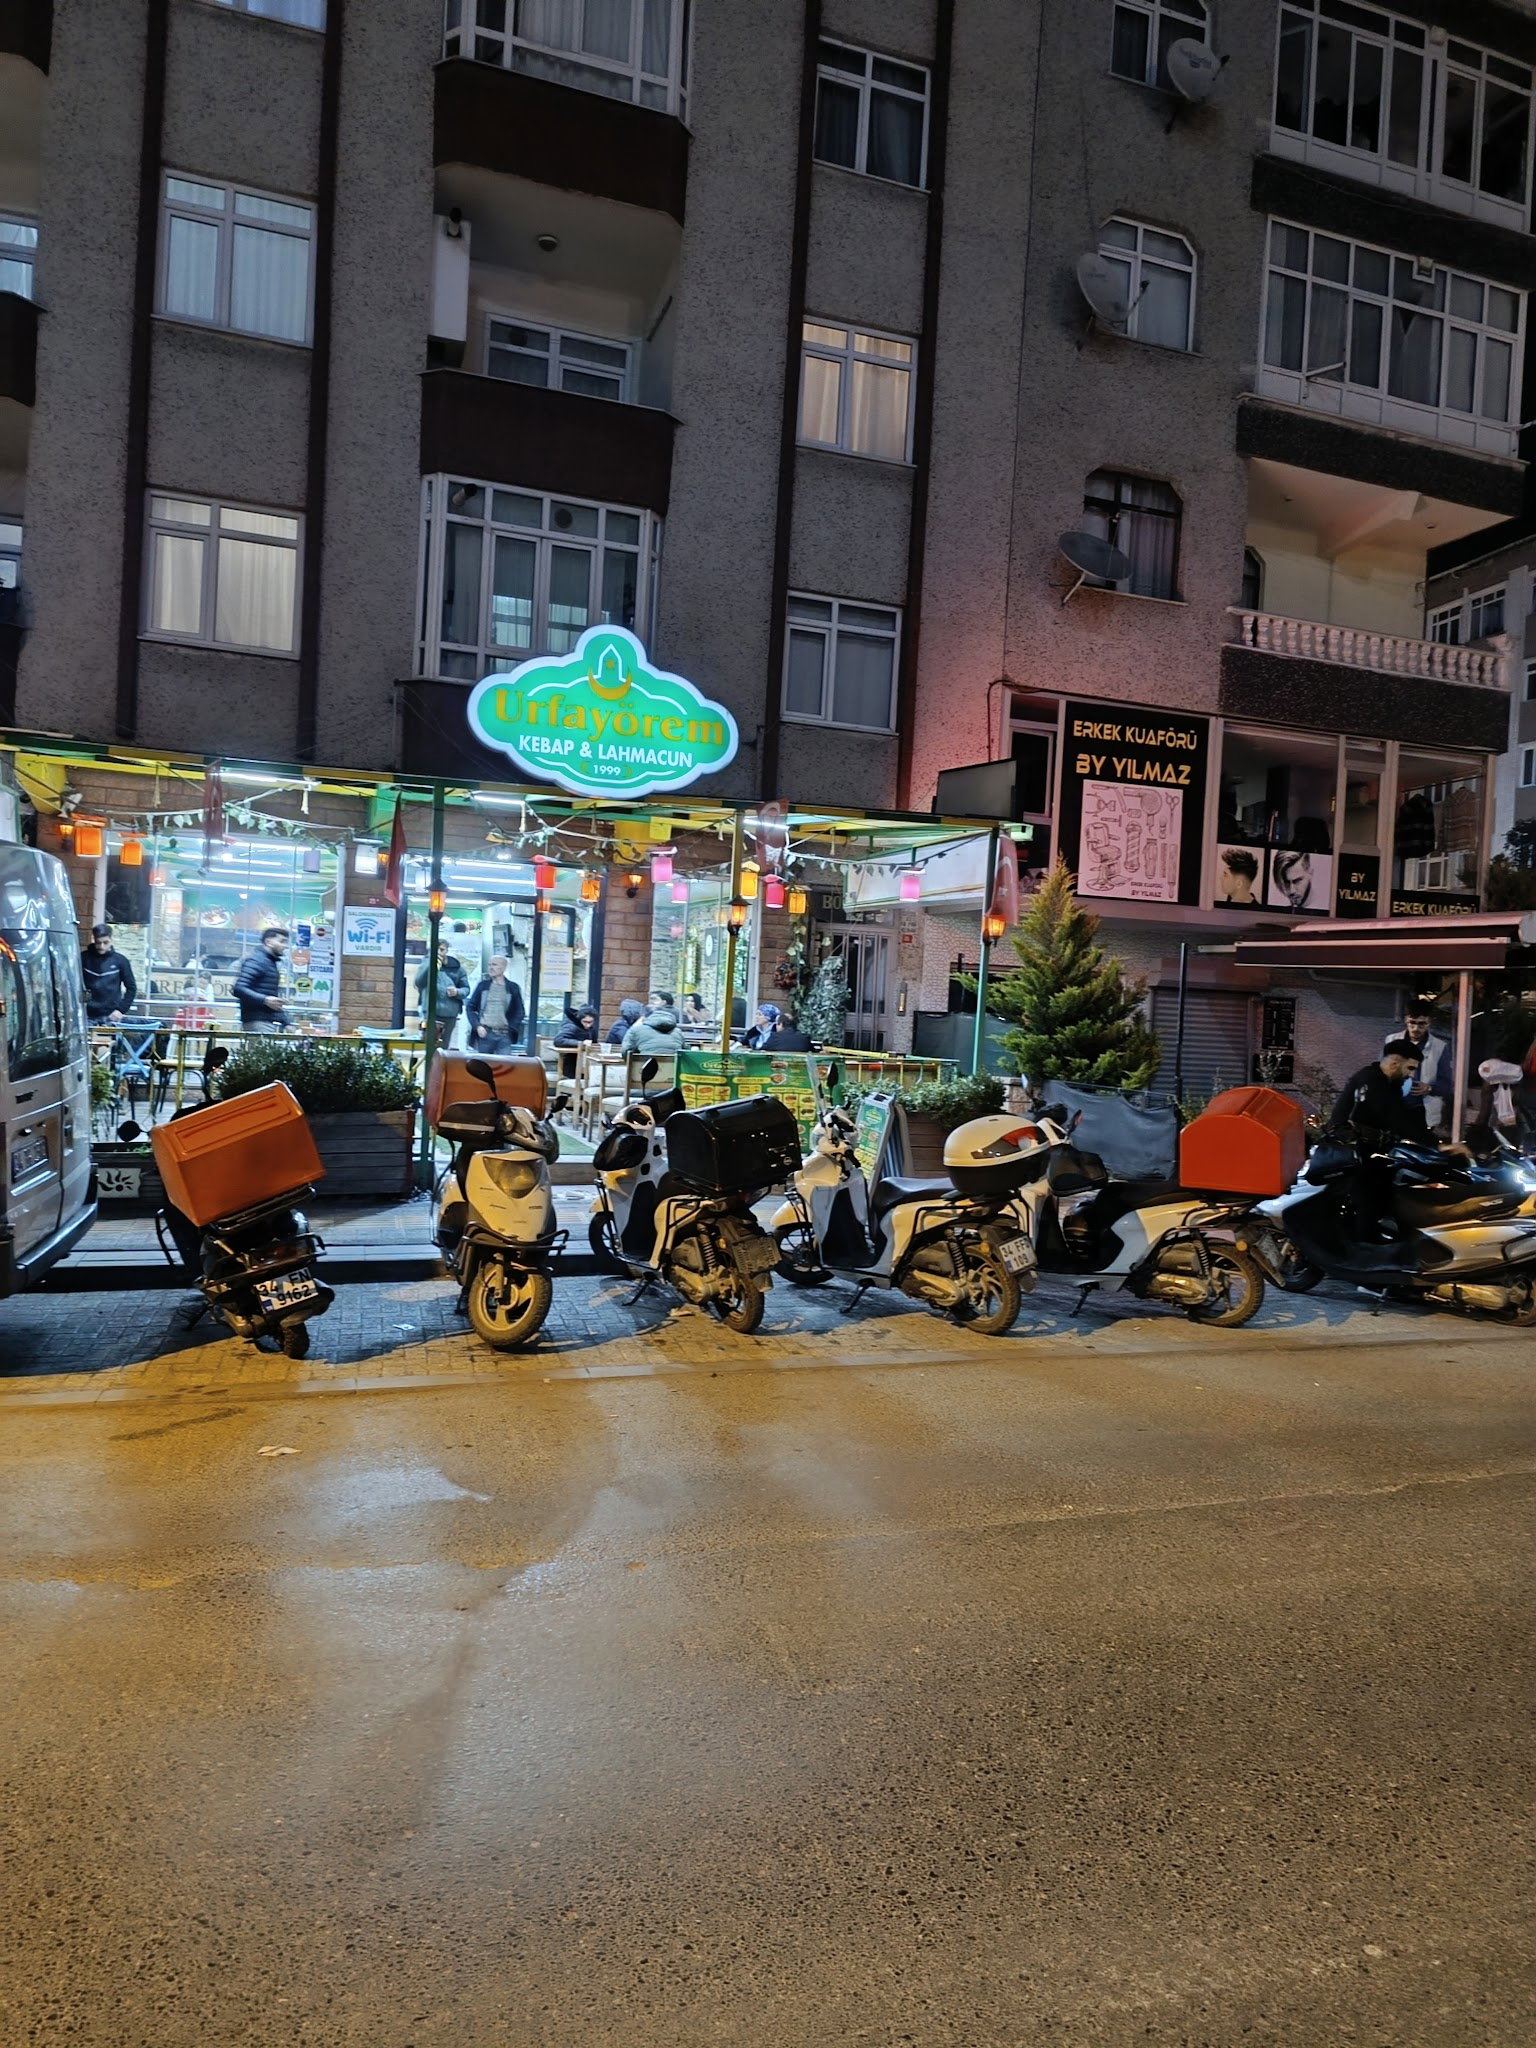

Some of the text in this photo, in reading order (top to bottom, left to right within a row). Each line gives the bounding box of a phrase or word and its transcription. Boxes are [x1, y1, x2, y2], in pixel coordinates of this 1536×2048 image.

[494, 689, 723, 746] Urfayörem
[1073, 720, 1198, 750] ERKEK KUAFÖRÜ
[519, 735, 693, 768] KEBAP & LAHMACUN
[593, 764, 621, 776] 1999
[1076, 753, 1192, 785] BY YILMAZ
[1350, 873, 1365, 883] BY
[1339, 888, 1376, 902] YILMAZ
[1393, 902, 1426, 915] ERKEK
[347, 930, 391, 944] Wi-Fi
[258, 1280, 279, 1297] 34
[276, 1284, 312, 1306] 9162
